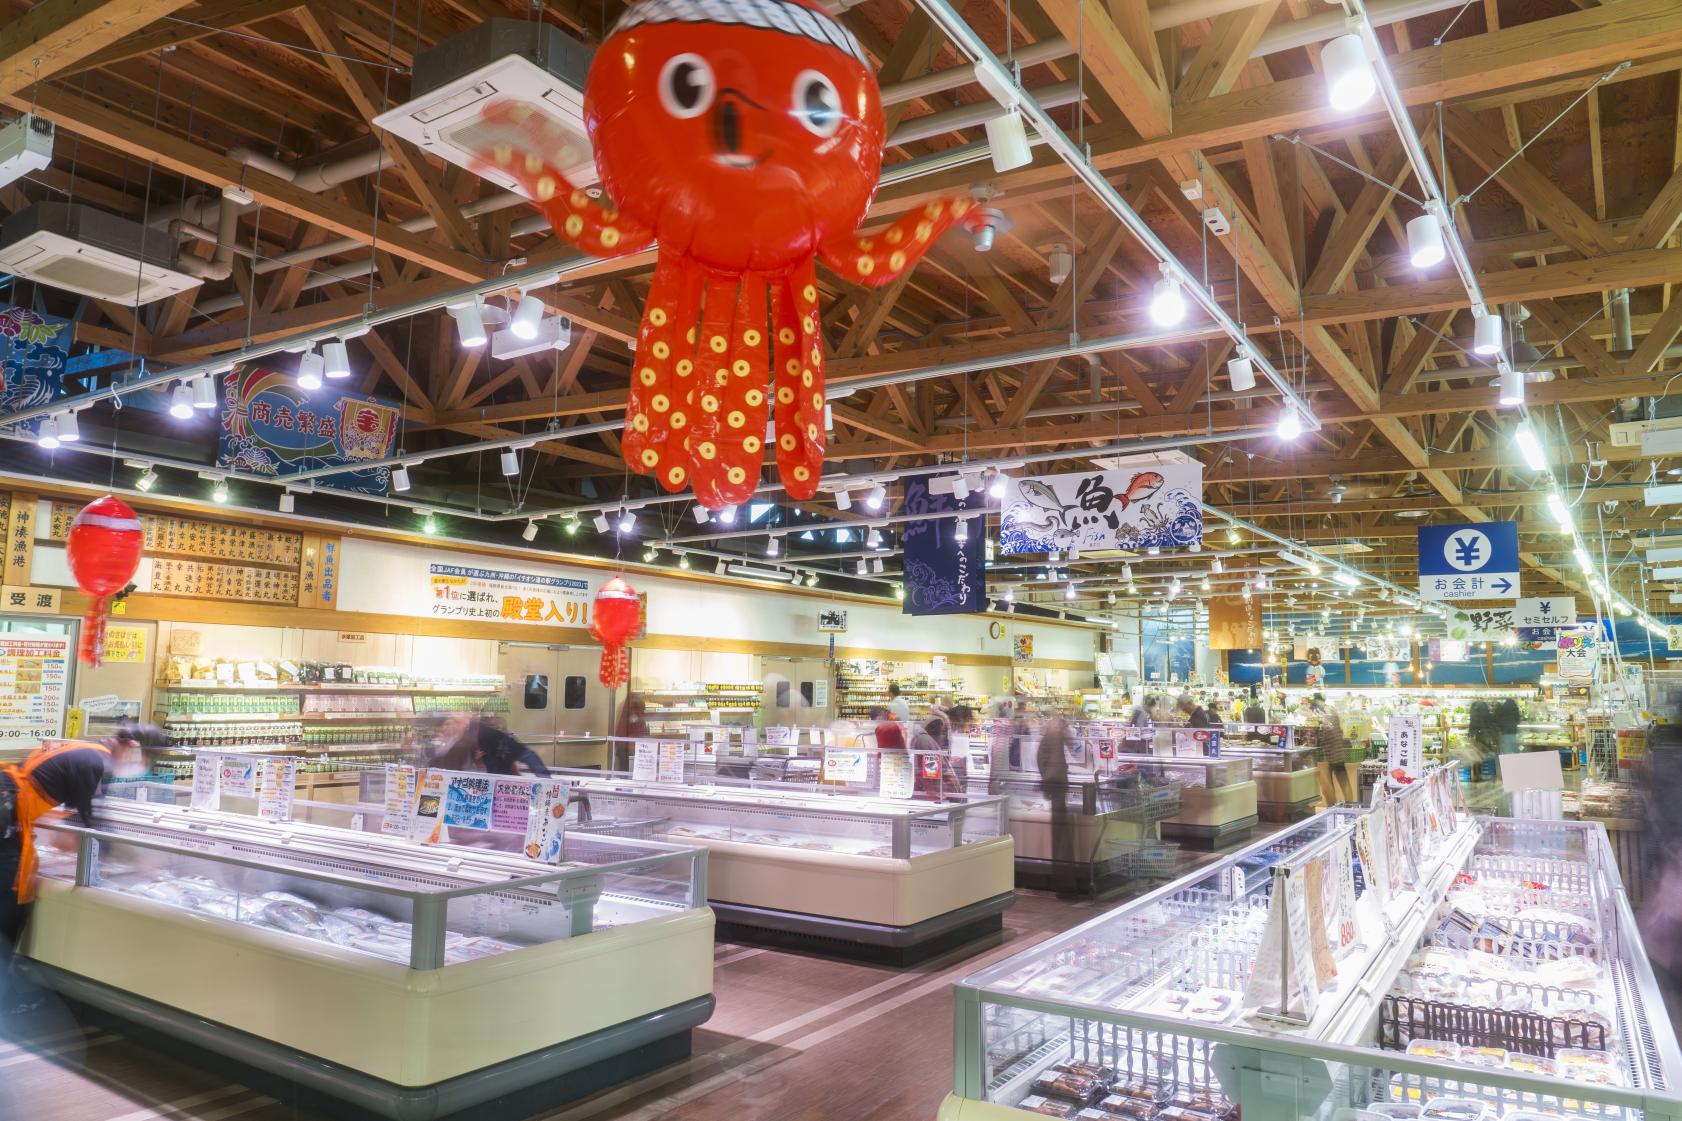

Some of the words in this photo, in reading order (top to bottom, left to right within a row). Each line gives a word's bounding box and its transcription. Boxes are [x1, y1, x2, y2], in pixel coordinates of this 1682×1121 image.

[251, 400, 337, 439] 商売繁盛
[1072, 474, 1119, 529] 魚
[12, 511, 30, 568] 神湊漁港
[1434, 577, 1485, 590] お会計
[10, 592, 53, 608] 受渡
[1443, 590, 1476, 598] cashier
[432, 604, 500, 618] グランプリ史上初の
[500, 596, 588, 625] 殿堂入り!
[1469, 610, 1516, 633] 野菜
[1523, 615, 1570, 625] セミセルフ
[1558, 636, 1595, 649] ぬりえ
[6, 649, 61, 657] 調理加工料金
[1566, 649, 1586, 658] 大会
